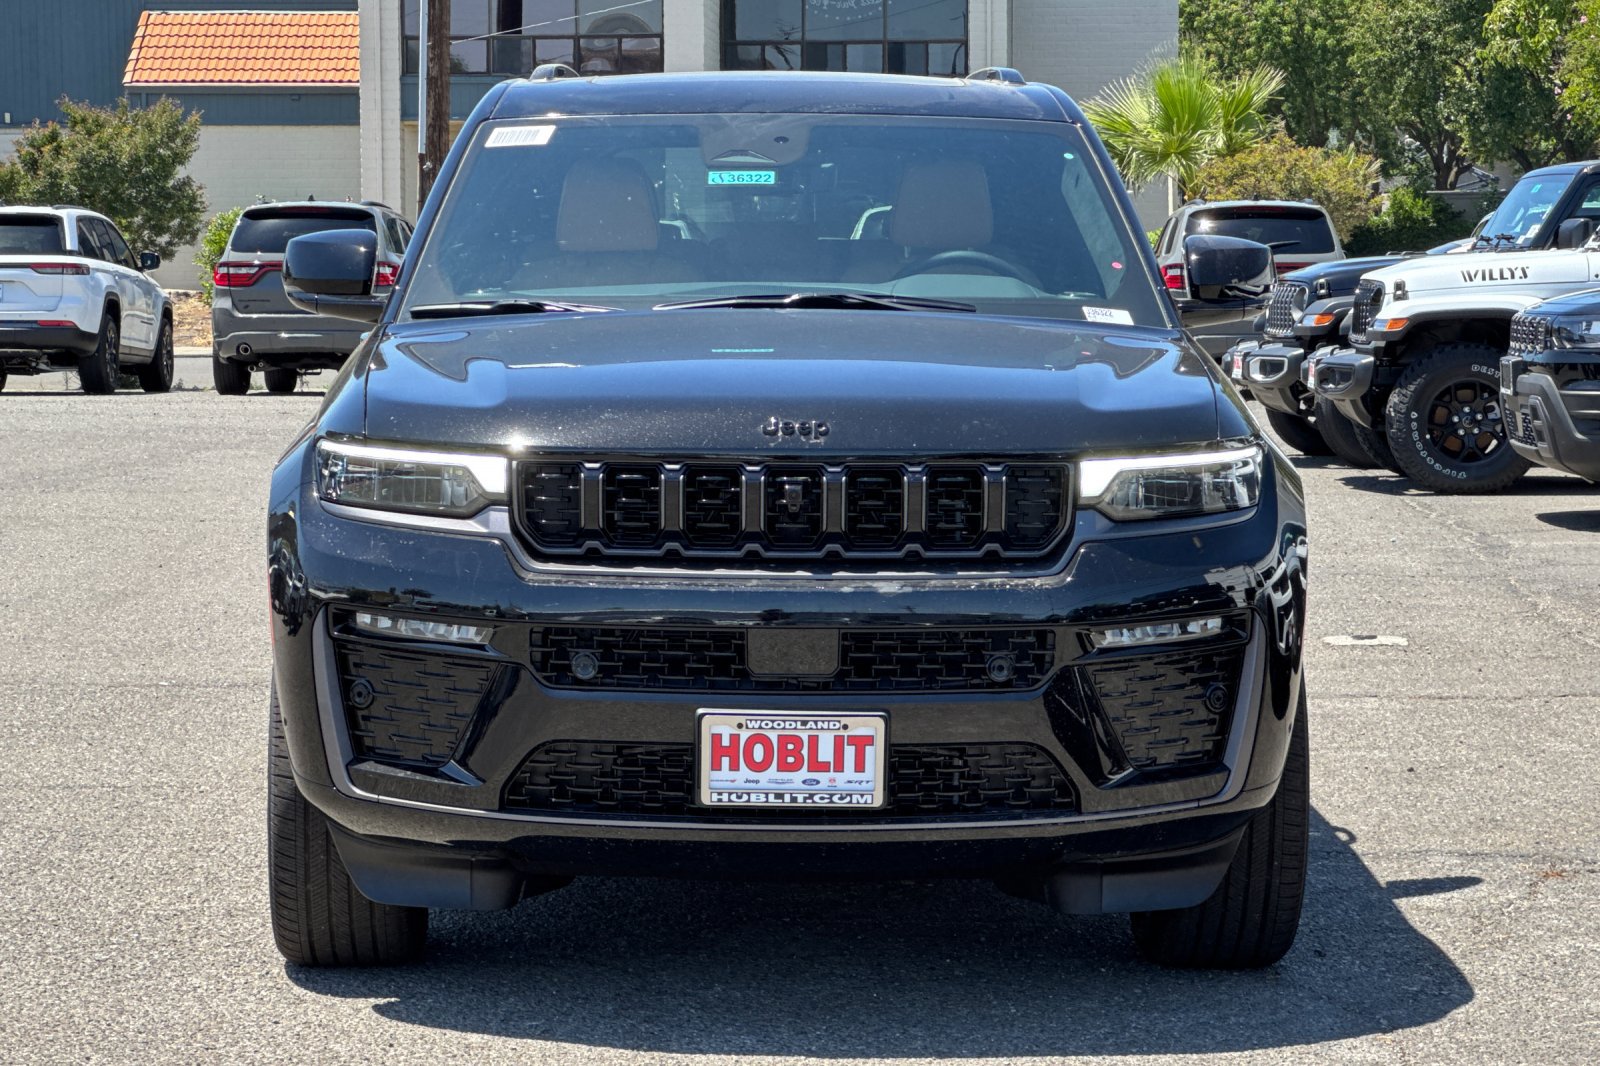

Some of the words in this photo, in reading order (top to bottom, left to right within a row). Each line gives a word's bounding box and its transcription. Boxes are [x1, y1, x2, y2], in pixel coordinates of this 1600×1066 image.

[1460, 266, 1530, 283] WILLYS
[762, 416, 830, 441] Jeep
[745, 719, 841, 730] WOODLAND
[711, 732, 875, 773] HOBLIT
[743, 777, 761, 785] Jeep
[711, 792, 873, 804] HOBLIT.COM
